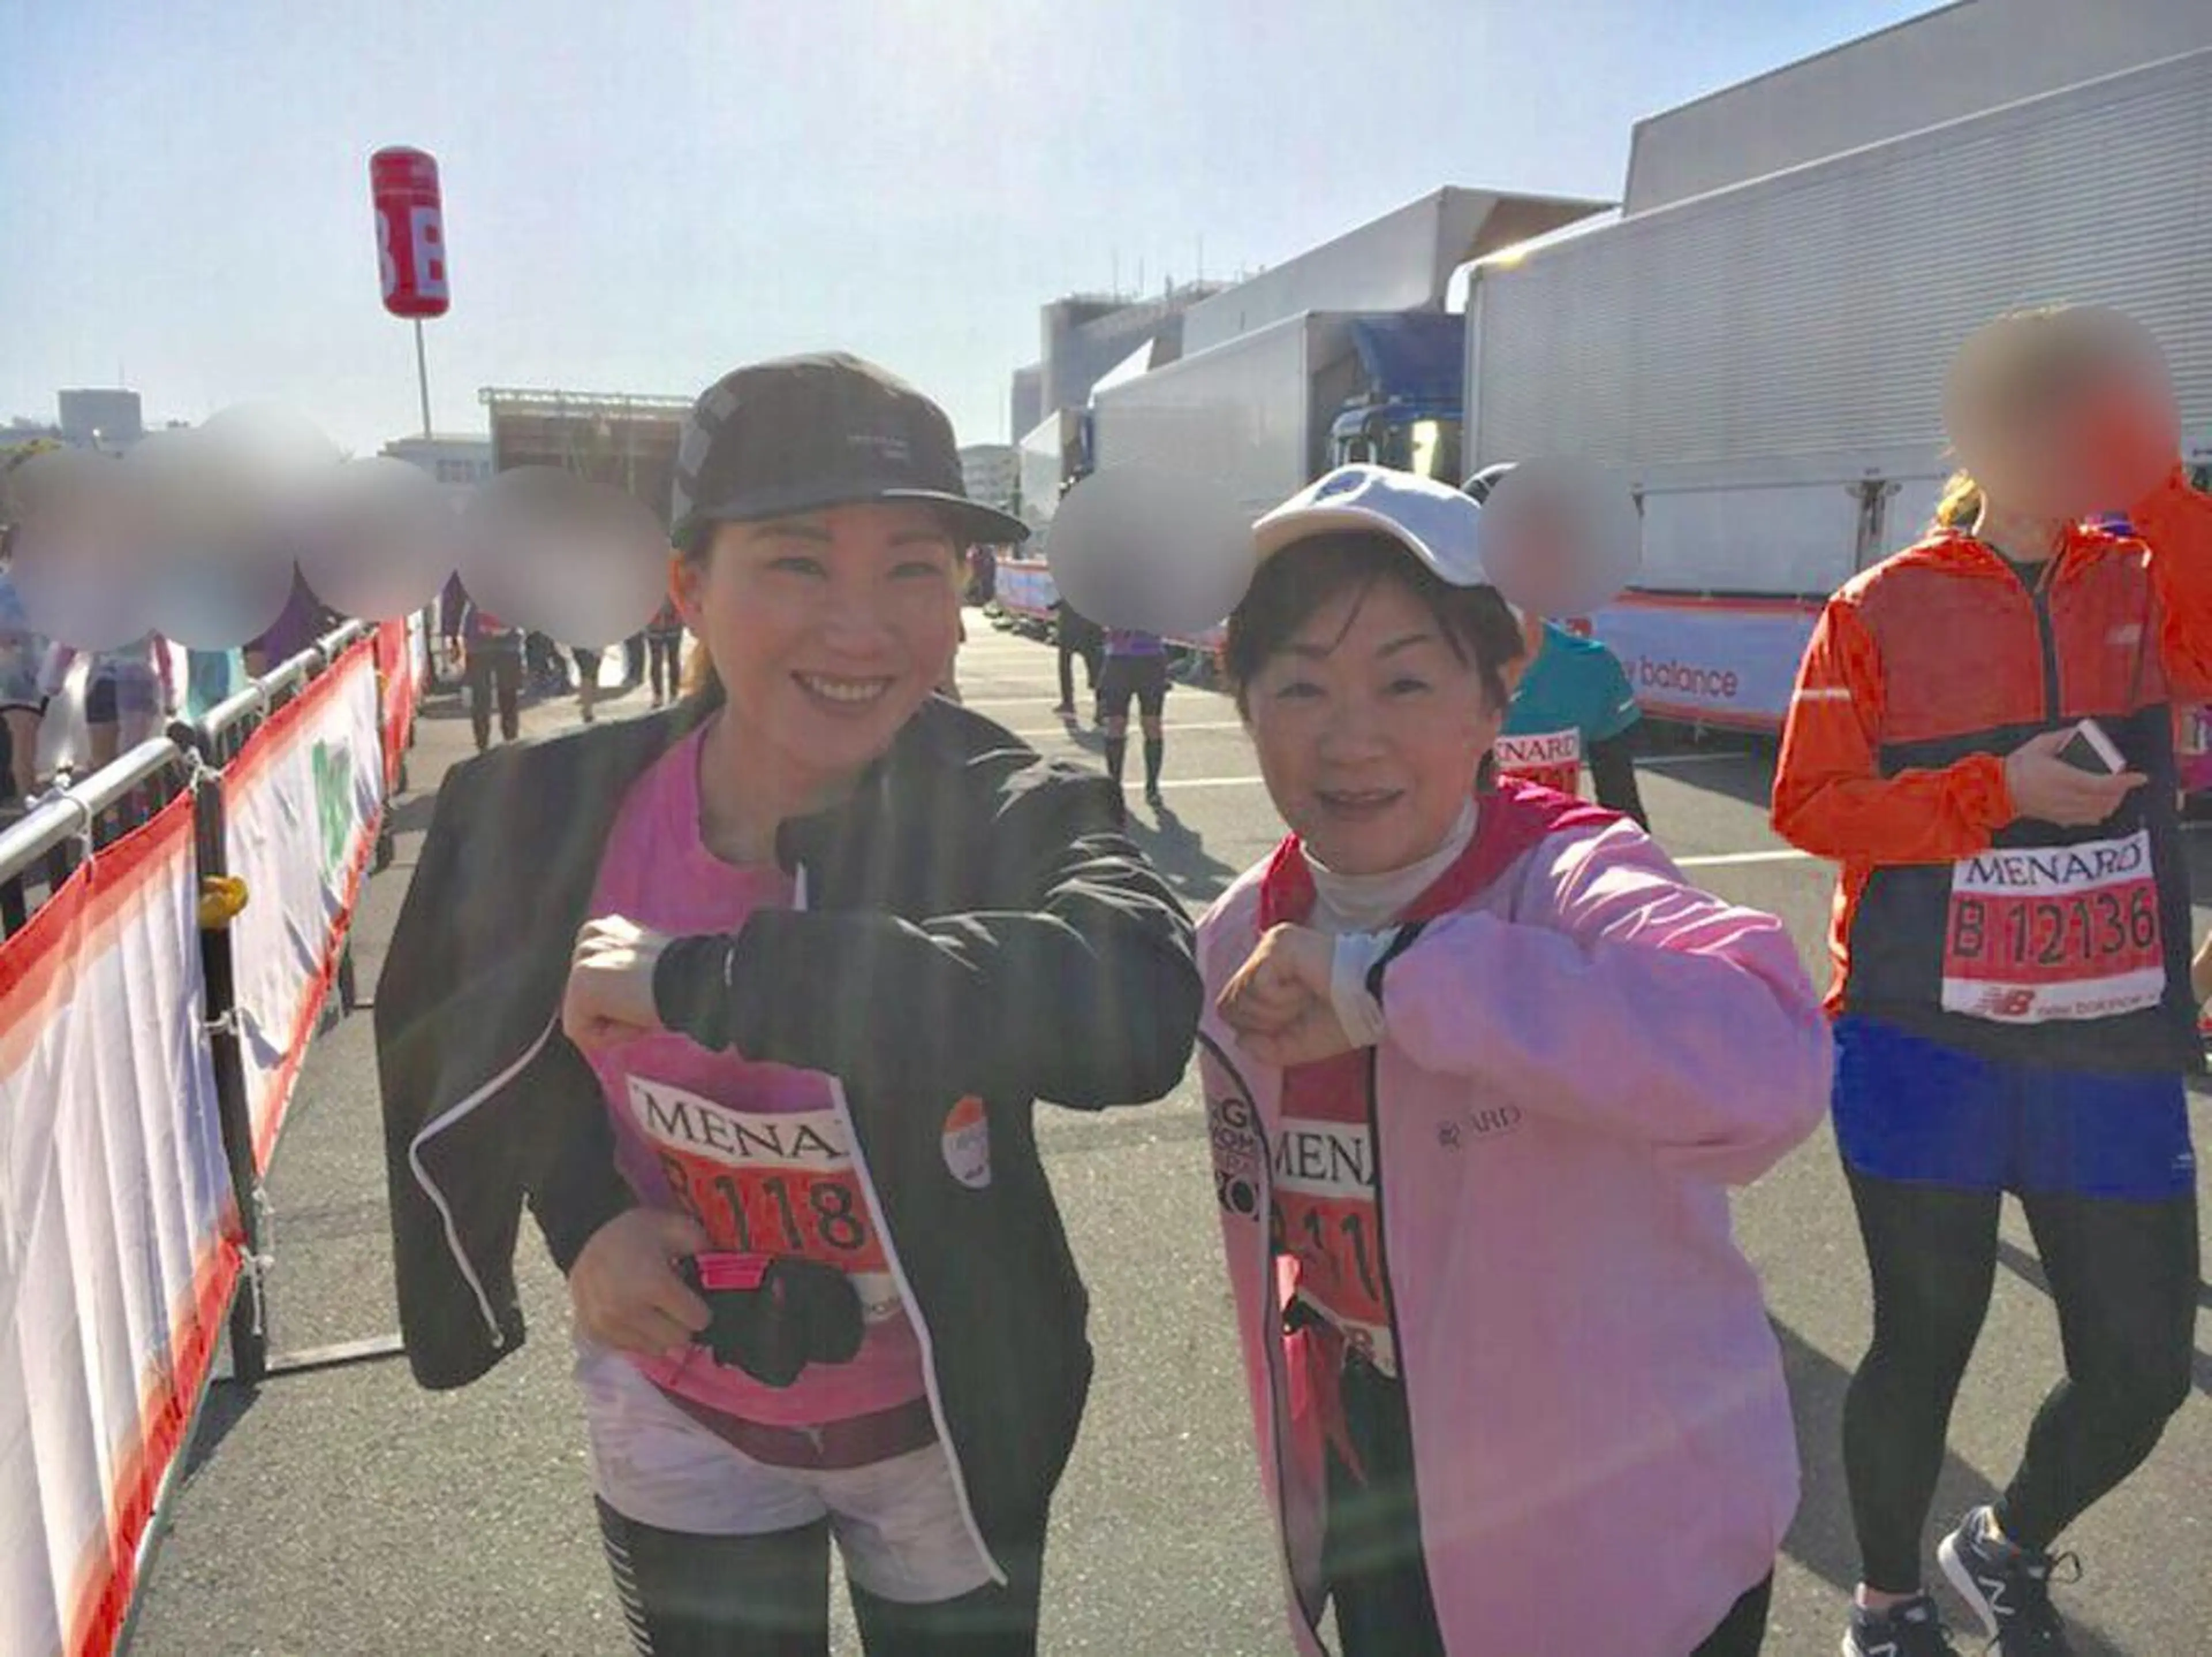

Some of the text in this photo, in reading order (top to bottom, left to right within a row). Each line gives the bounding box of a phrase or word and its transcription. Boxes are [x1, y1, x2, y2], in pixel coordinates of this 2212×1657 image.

[1640, 655, 1738, 697] balance
[1965, 843, 2142, 886] MENARD
[1953, 888, 2154, 965] B 12136
[644, 1092, 845, 1158] MENA
[714, 1174, 865, 1253] 118
